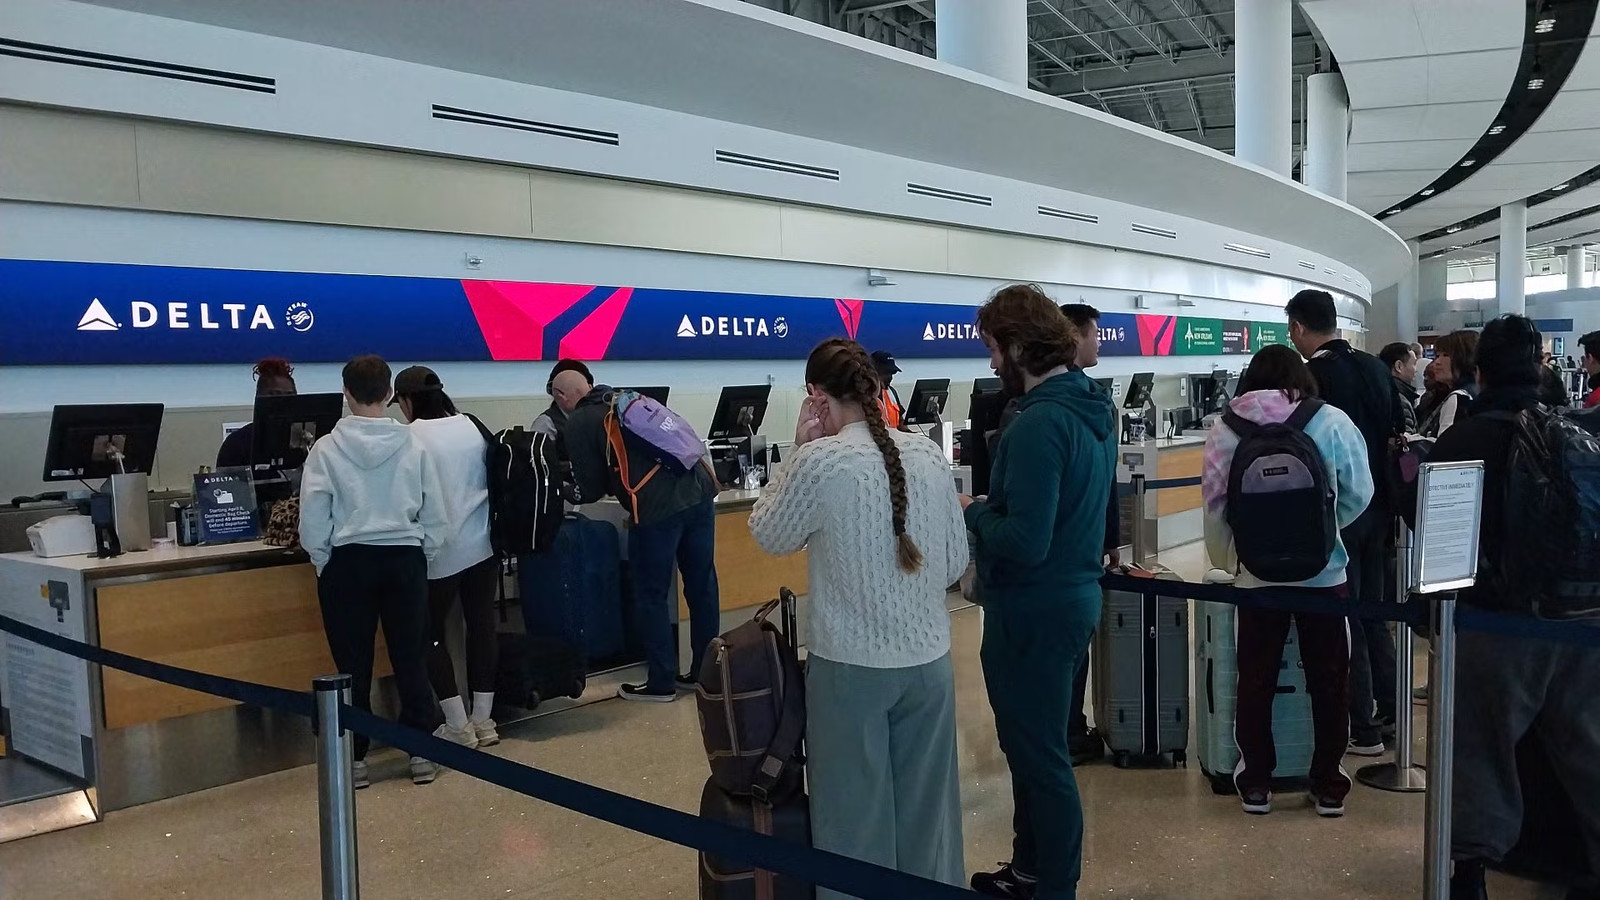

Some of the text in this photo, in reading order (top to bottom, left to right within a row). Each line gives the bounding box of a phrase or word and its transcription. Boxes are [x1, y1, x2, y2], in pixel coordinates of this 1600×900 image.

[131, 301, 275, 329] DELTA
[701, 316, 769, 337] DELTA
[937, 323, 979, 340] DELTA
[1097, 327, 1118, 341] ELTA
